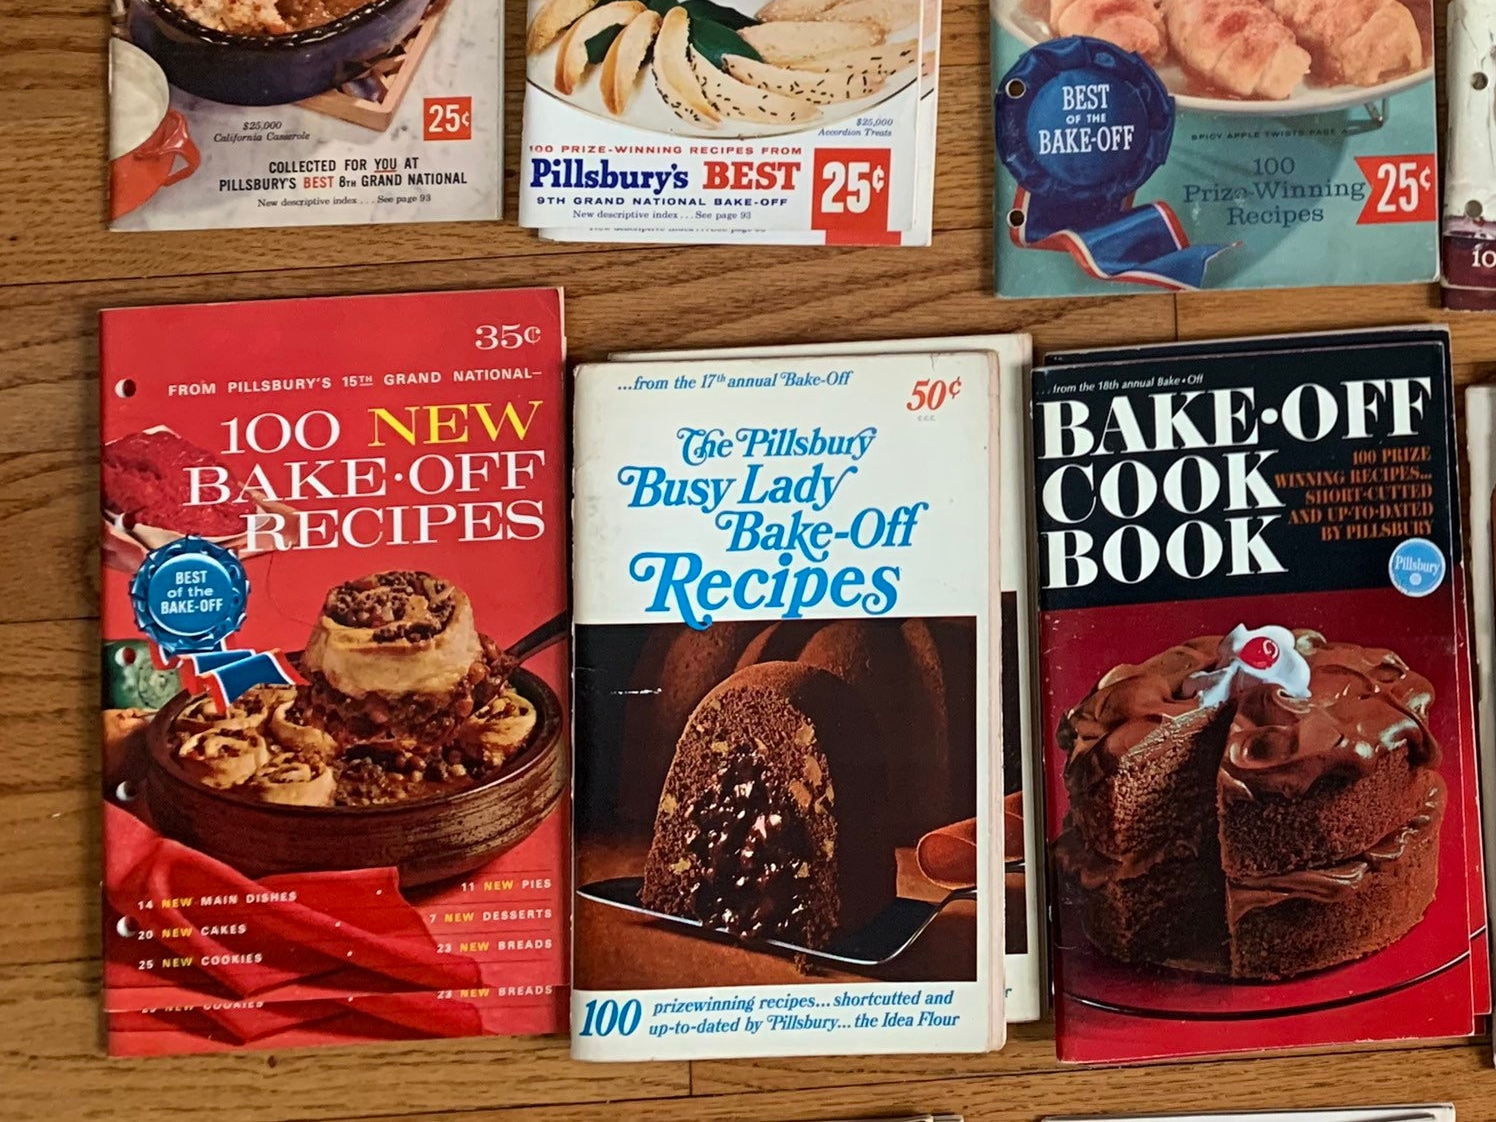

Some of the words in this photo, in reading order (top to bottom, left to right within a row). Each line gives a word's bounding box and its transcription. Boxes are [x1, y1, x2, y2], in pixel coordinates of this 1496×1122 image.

[1062, 85, 1110, 110] BEST
[428, 105, 470, 132] 25¢
[1038, 125, 1135, 155] BAKE-OFF
[269, 160, 336, 174] COLLECTED
[344, 159, 367, 171] FOR
[374, 158, 397, 172] YOU
[404, 157, 419, 170] AT
[530, 158, 689, 195] Pillsbury's
[703, 161, 801, 190] BEST
[537, 197, 566, 205] 9TH
[573, 197, 625, 206] GRAND
[632, 197, 707, 206] NATIONAL
[714, 197, 788, 206] BAKE-OFF
[821, 161, 885, 214] 25¢
[1377, 162, 1431, 213] 25¢
[1226, 206, 1324, 228] Recipes
[475, 324, 541, 350] 35¢
[906, 377, 962, 412] 50¢
[220, 410, 340, 455] 100
[367, 401, 544, 447] NEW
[1352, 450, 1376, 465] 100
[1382, 447, 1431, 463] PRIZE
[618, 465, 735, 513] Busy
[737, 464, 858, 511] Lady
[1042, 449, 1286, 524] COOK
[240, 499, 546, 552] RECIPES
[1042, 515, 1289, 590] BOOK
[1394, 556, 1440, 577] Pillsbury
[629, 552, 902, 631] Recipes
[137, 900, 153, 910] 14
[161, 897, 192, 909] NEW
[200, 894, 238, 906] MAIN
[246, 891, 297, 904] DISHES
[579, 998, 642, 1037] 100
[653, 996, 754, 1016] prizewinning
[834, 992, 921, 1007] shortcutted
[925, 990, 953, 1005] and
